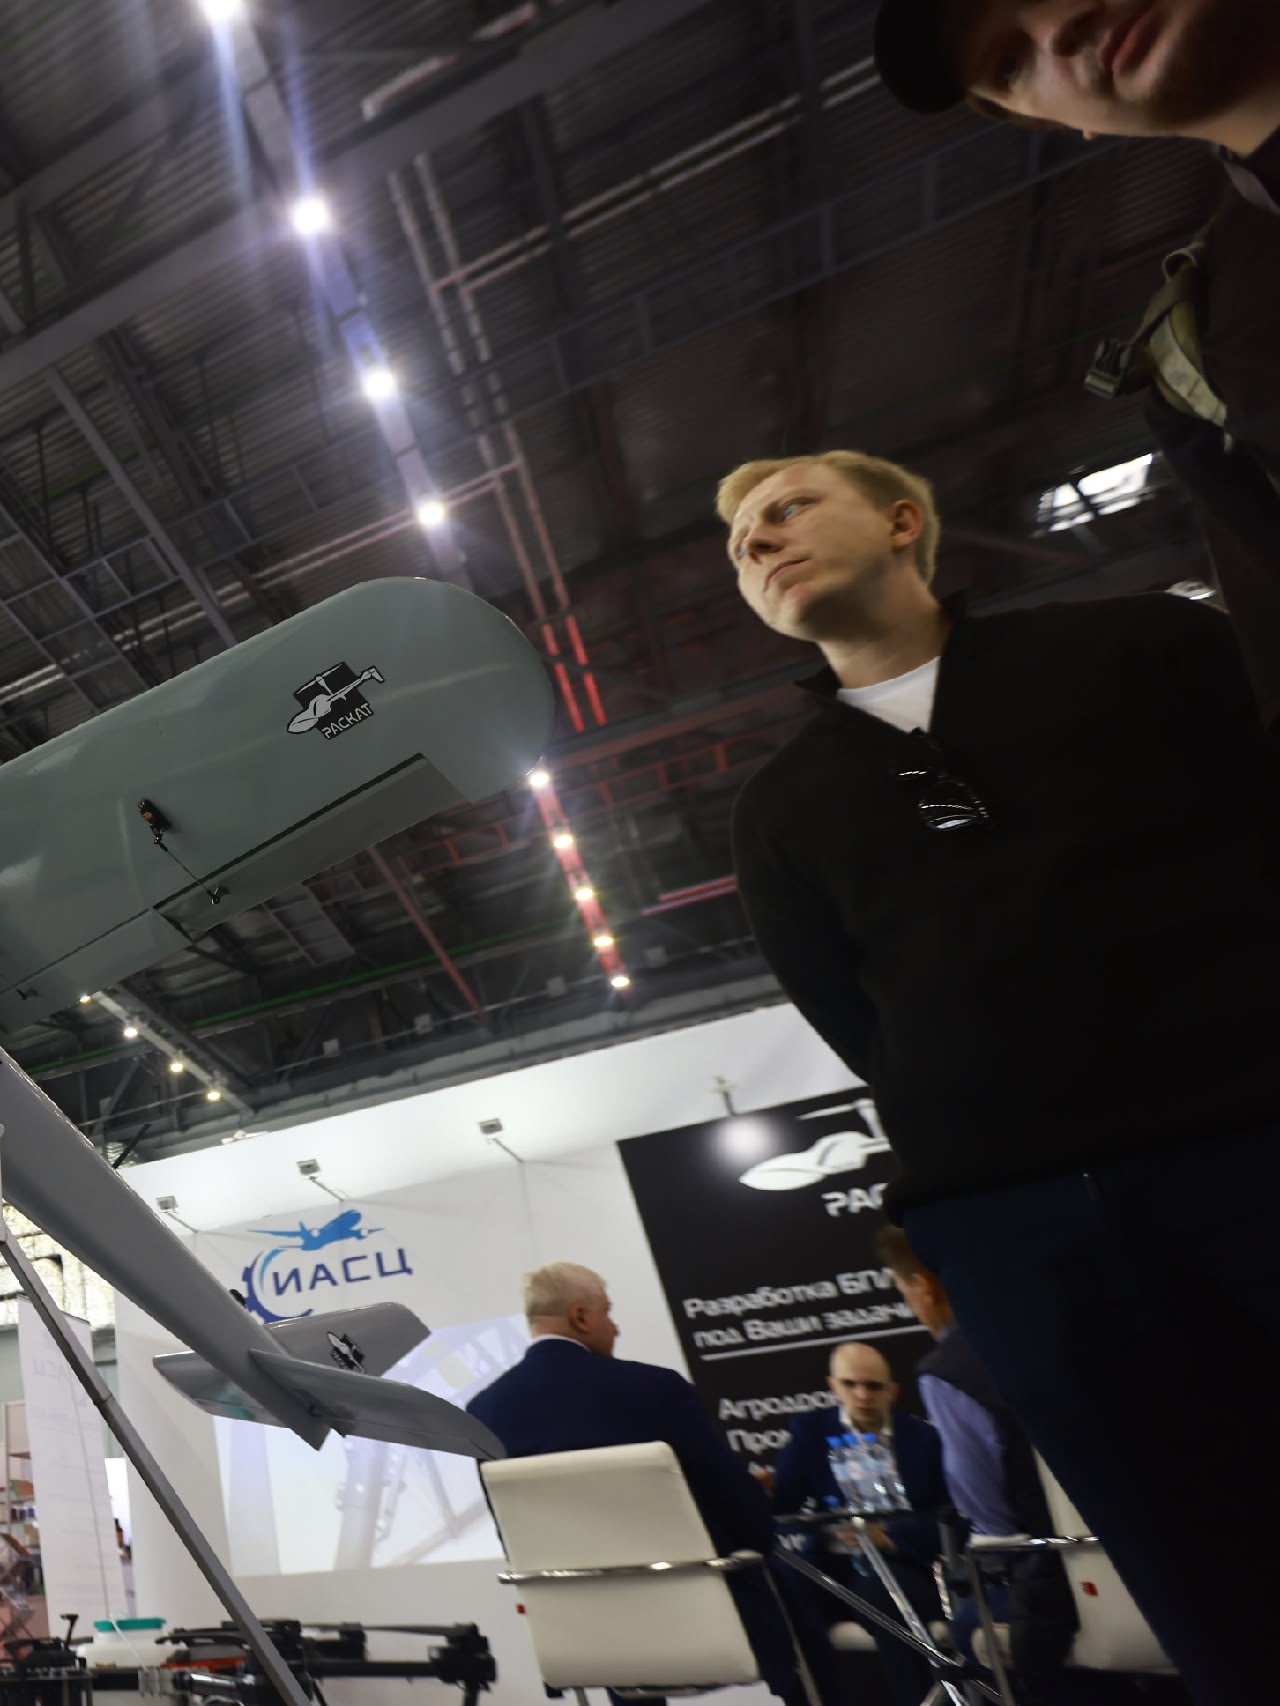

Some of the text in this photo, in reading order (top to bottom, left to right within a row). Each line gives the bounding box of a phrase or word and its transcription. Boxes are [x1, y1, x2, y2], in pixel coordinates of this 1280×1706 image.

[322, 703, 372, 739] РАСКАТ
[272, 1248, 413, 1296] ИАСЦ
[682, 1267, 896, 1318] Разработка БПЛ
[693, 1327, 746, 1348] под
[742, 1316, 823, 1340] Ваши
